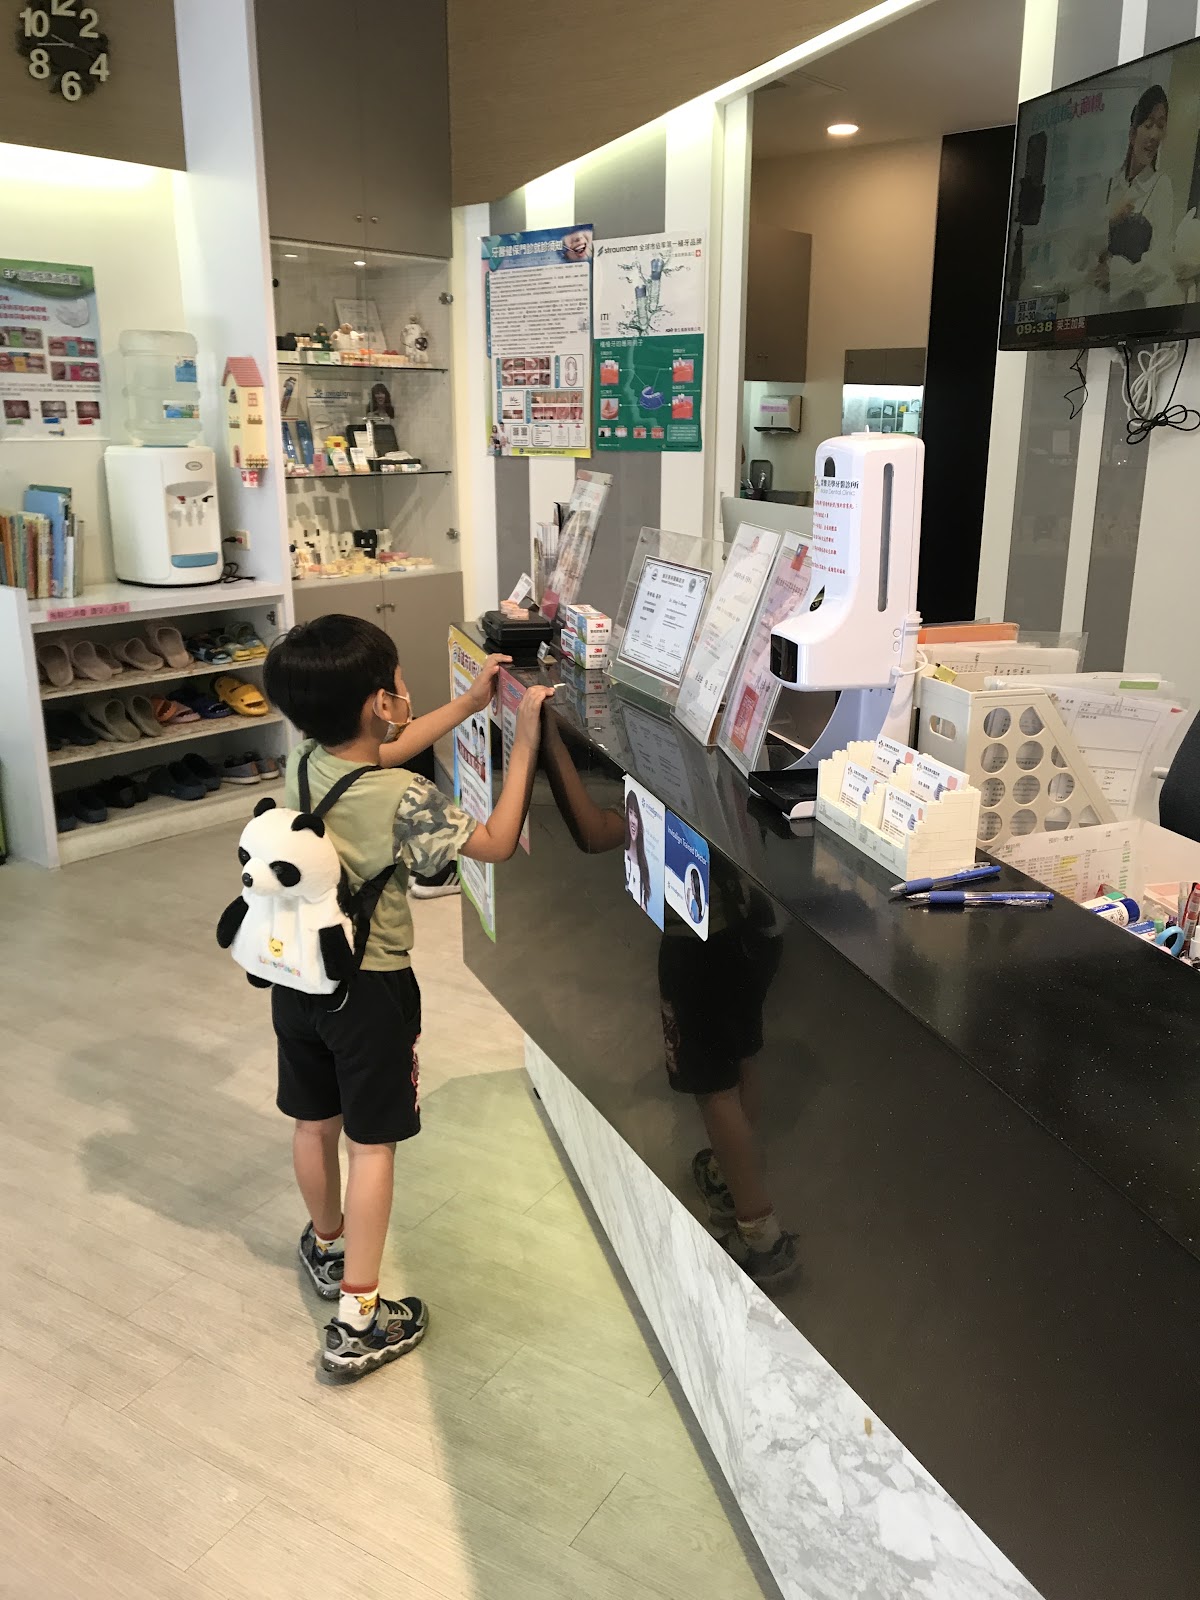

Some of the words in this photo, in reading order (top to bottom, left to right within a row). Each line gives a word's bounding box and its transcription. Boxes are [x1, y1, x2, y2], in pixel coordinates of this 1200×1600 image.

[19, 7, 49, 38] 10
[79, 8, 99, 38] 2
[28, 48, 50, 79] 8
[89, 53, 110, 82] 4
[61, 70, 82, 101] 6
[604, 245, 638, 254] straumann
[1016, 321, 1053, 335] 09:38
[667, 825, 682, 845] Invisalign
[682, 837, 694, 854] Trained
[694, 849, 707, 865] Doctor
